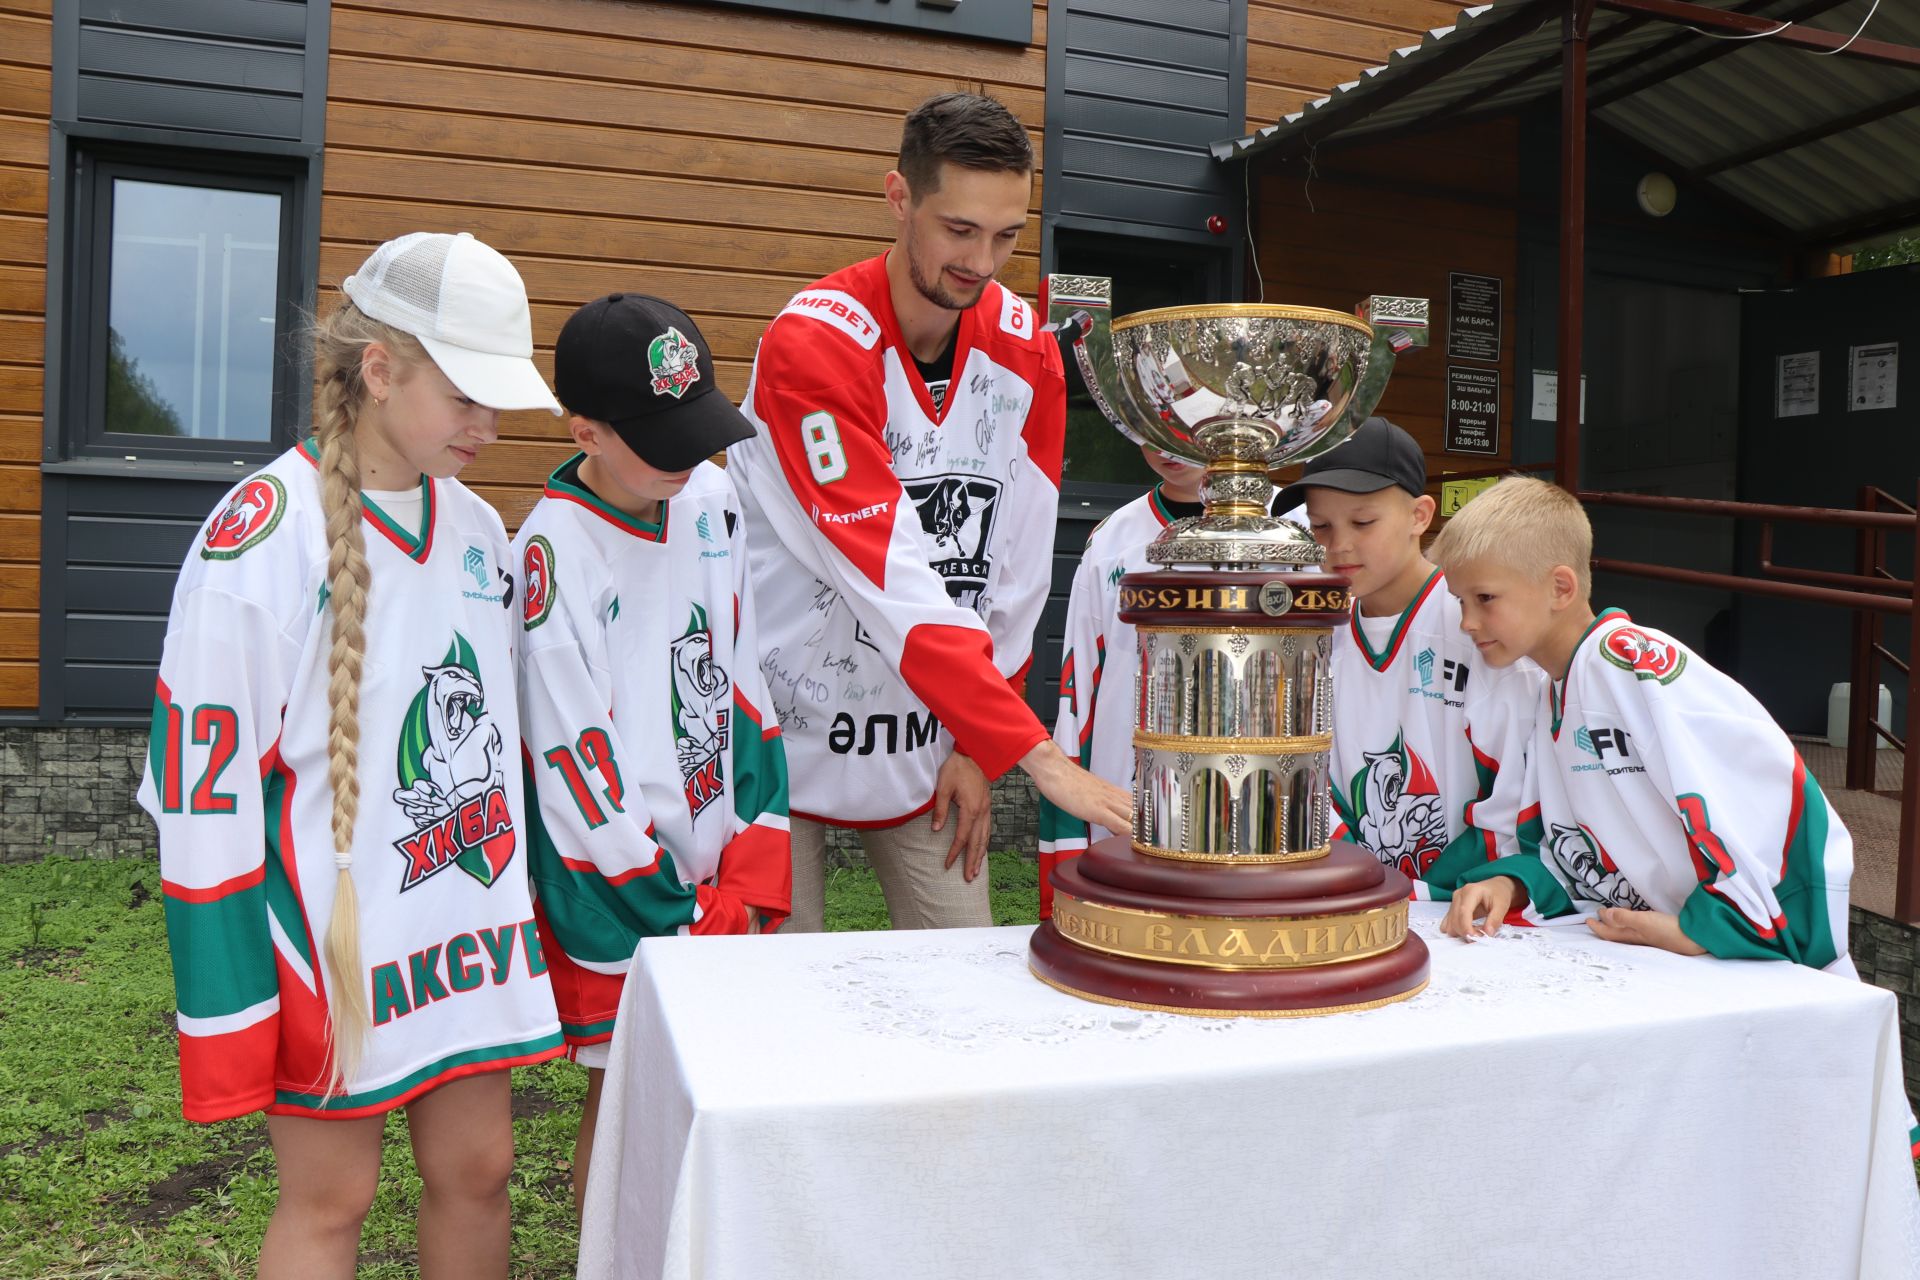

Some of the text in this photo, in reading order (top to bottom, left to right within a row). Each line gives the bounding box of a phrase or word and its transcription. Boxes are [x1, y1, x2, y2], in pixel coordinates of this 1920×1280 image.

[655, 366, 699, 391] ХК БАРС
[1451, 399, 1496, 414] 8:00-21:00
[1459, 418, 1487, 426] перерыв
[801, 410, 848, 485] 8
[1455, 437, 1490, 447] 12:00-13:00
[822, 501, 889, 524] TATNEFT
[162, 703, 239, 815] 12
[543, 727, 625, 831] 13
[397, 813, 461, 889] ХК
